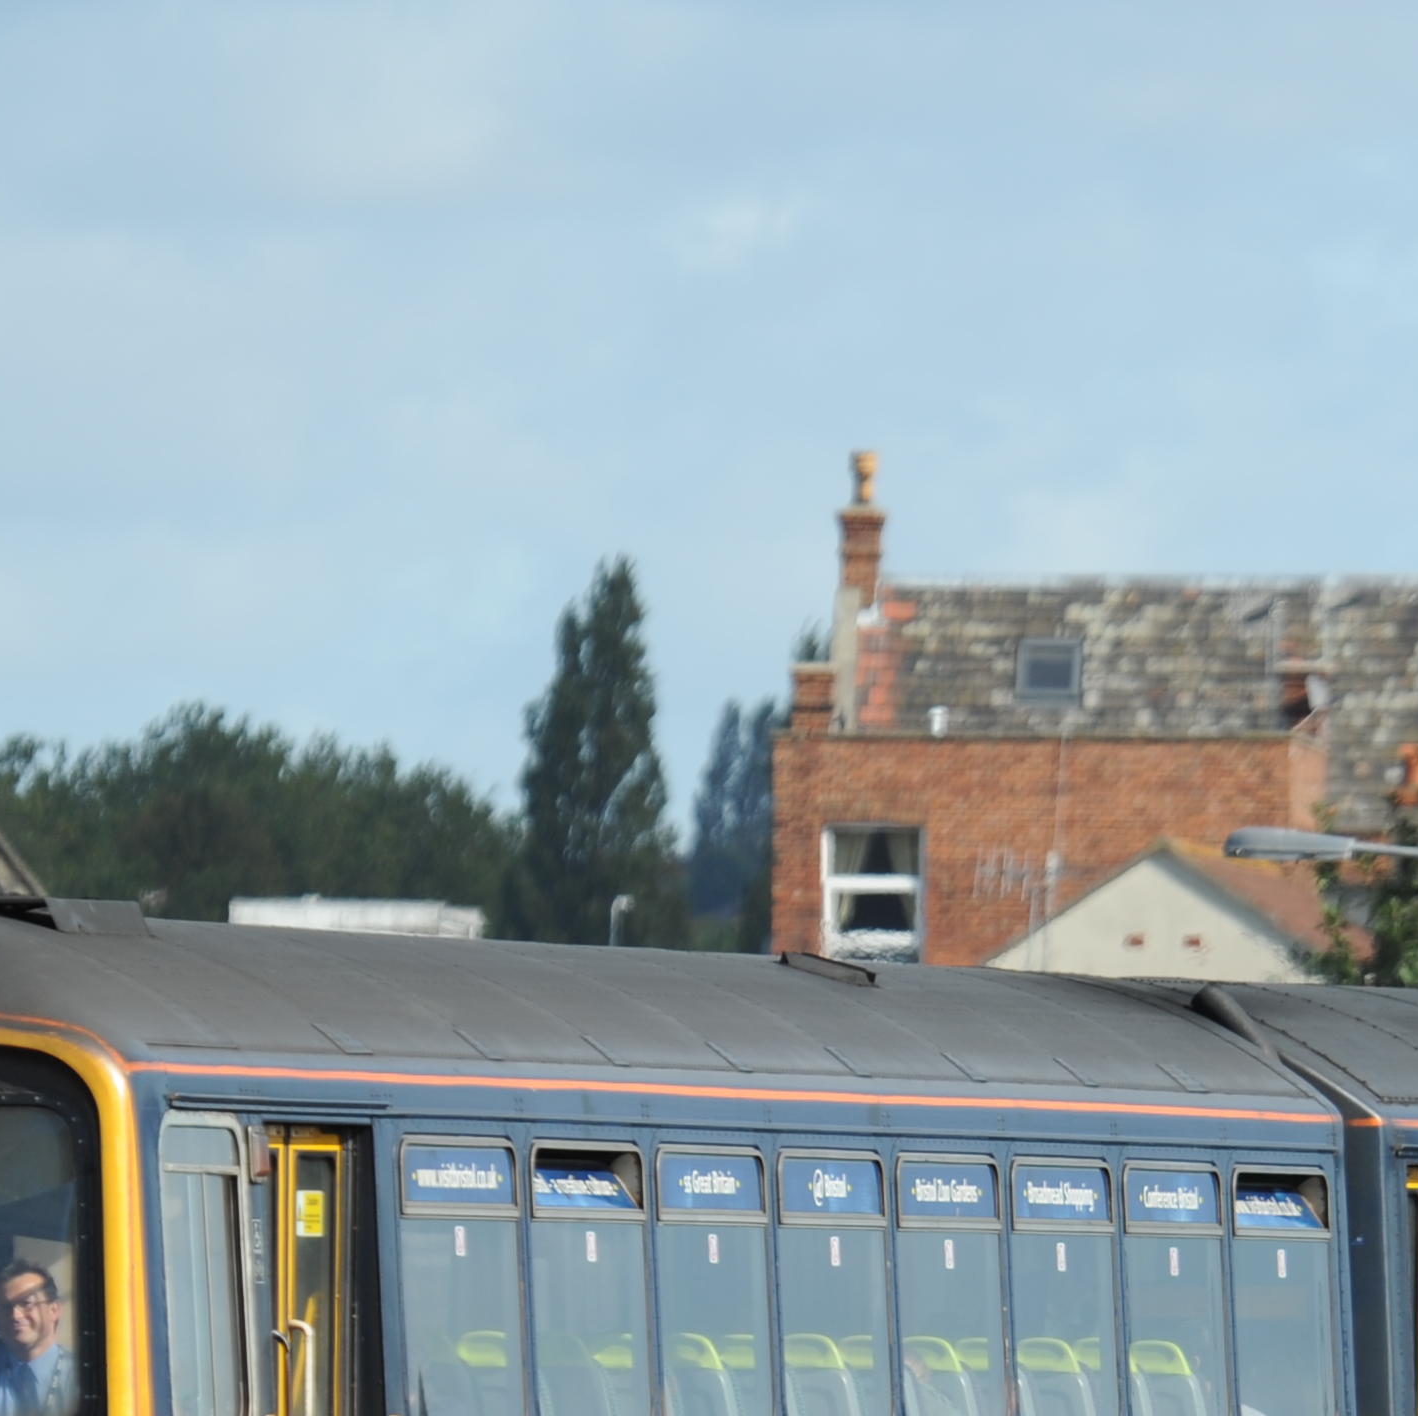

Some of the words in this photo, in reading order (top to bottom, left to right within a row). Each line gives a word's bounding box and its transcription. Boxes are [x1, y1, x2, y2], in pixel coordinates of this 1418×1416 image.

[416, 1162, 498, 1190] www.visitbristol.co.uk
[692, 1170, 713, 1194] Great
[713, 1170, 737, 1195] Britain
[824, 1173, 848, 1198] Bristol
[915, 1178, 937, 1202] Bristol
[950, 1178, 978, 1203] Gardens
[1063, 1182, 1095, 1212] Shopping
[1178, 1186, 1199, 1210] Bristol
